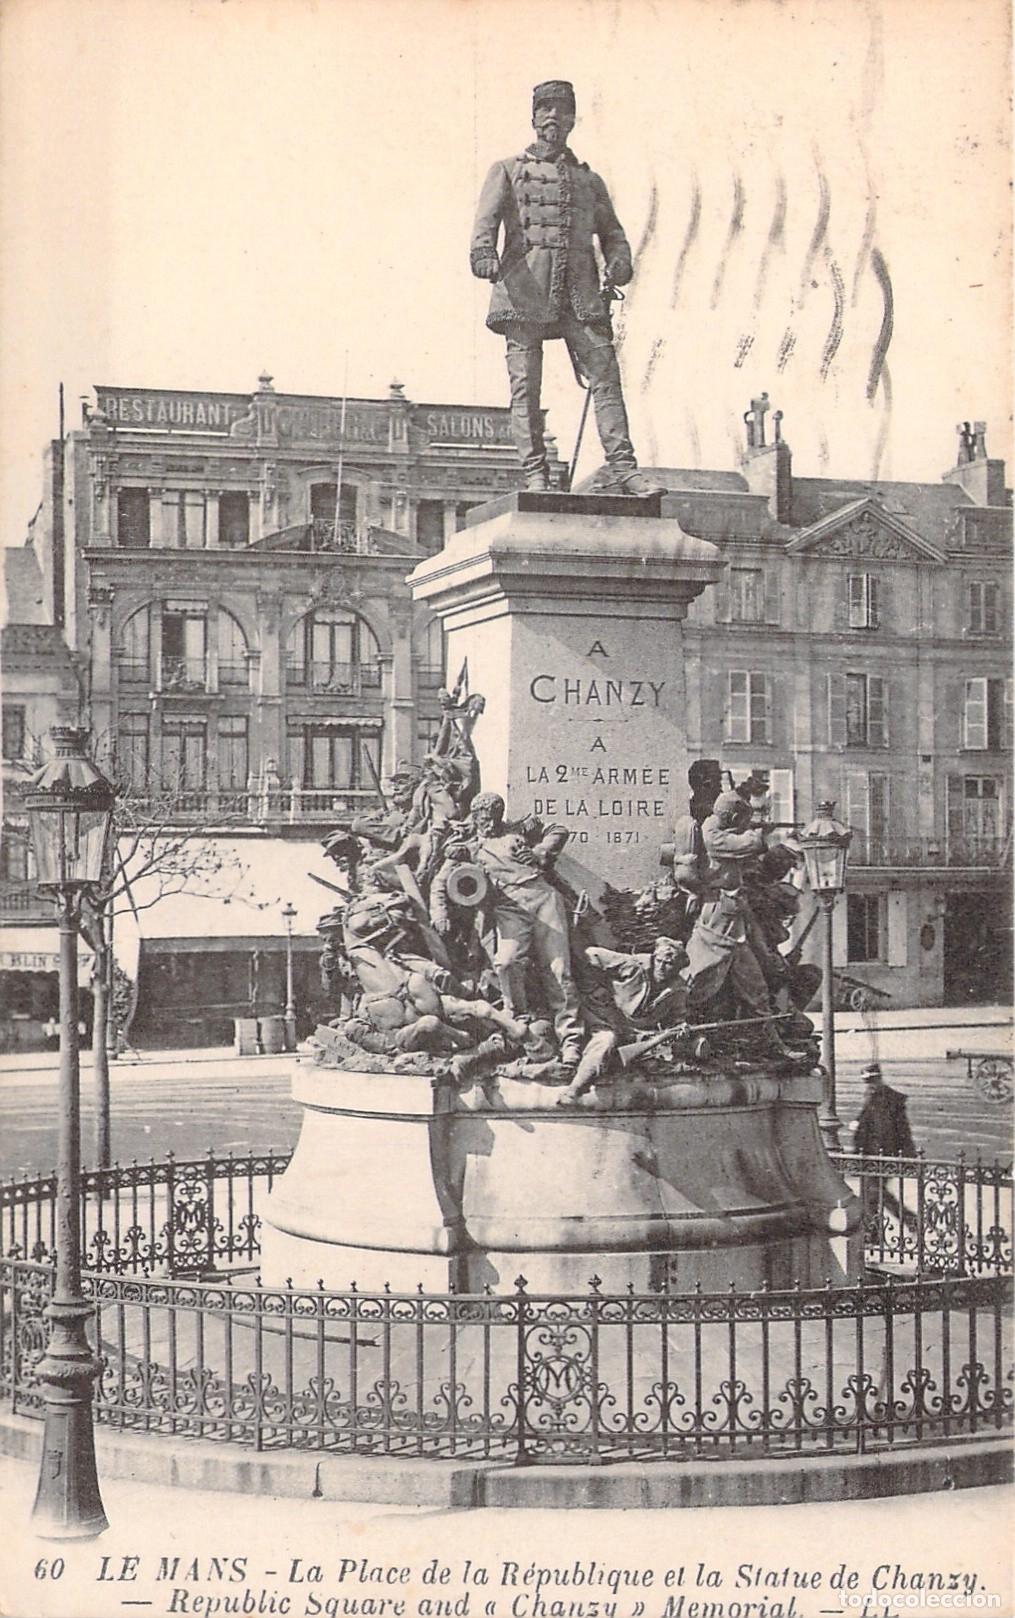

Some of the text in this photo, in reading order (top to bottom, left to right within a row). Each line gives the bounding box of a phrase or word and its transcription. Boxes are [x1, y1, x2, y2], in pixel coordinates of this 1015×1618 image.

[105, 397, 231, 425] RESTAURANT
[427, 414, 495, 438] SALONS
[586, 640, 610, 658] A
[530, 674, 666, 707] CHANZY
[590, 736, 607, 752] A
[527, 766, 549, 783] LA
[592, 764, 670, 785] ARMÉE
[534, 799, 664, 816] DE LA LOIRE
[607, 831, 639, 843] 1871
